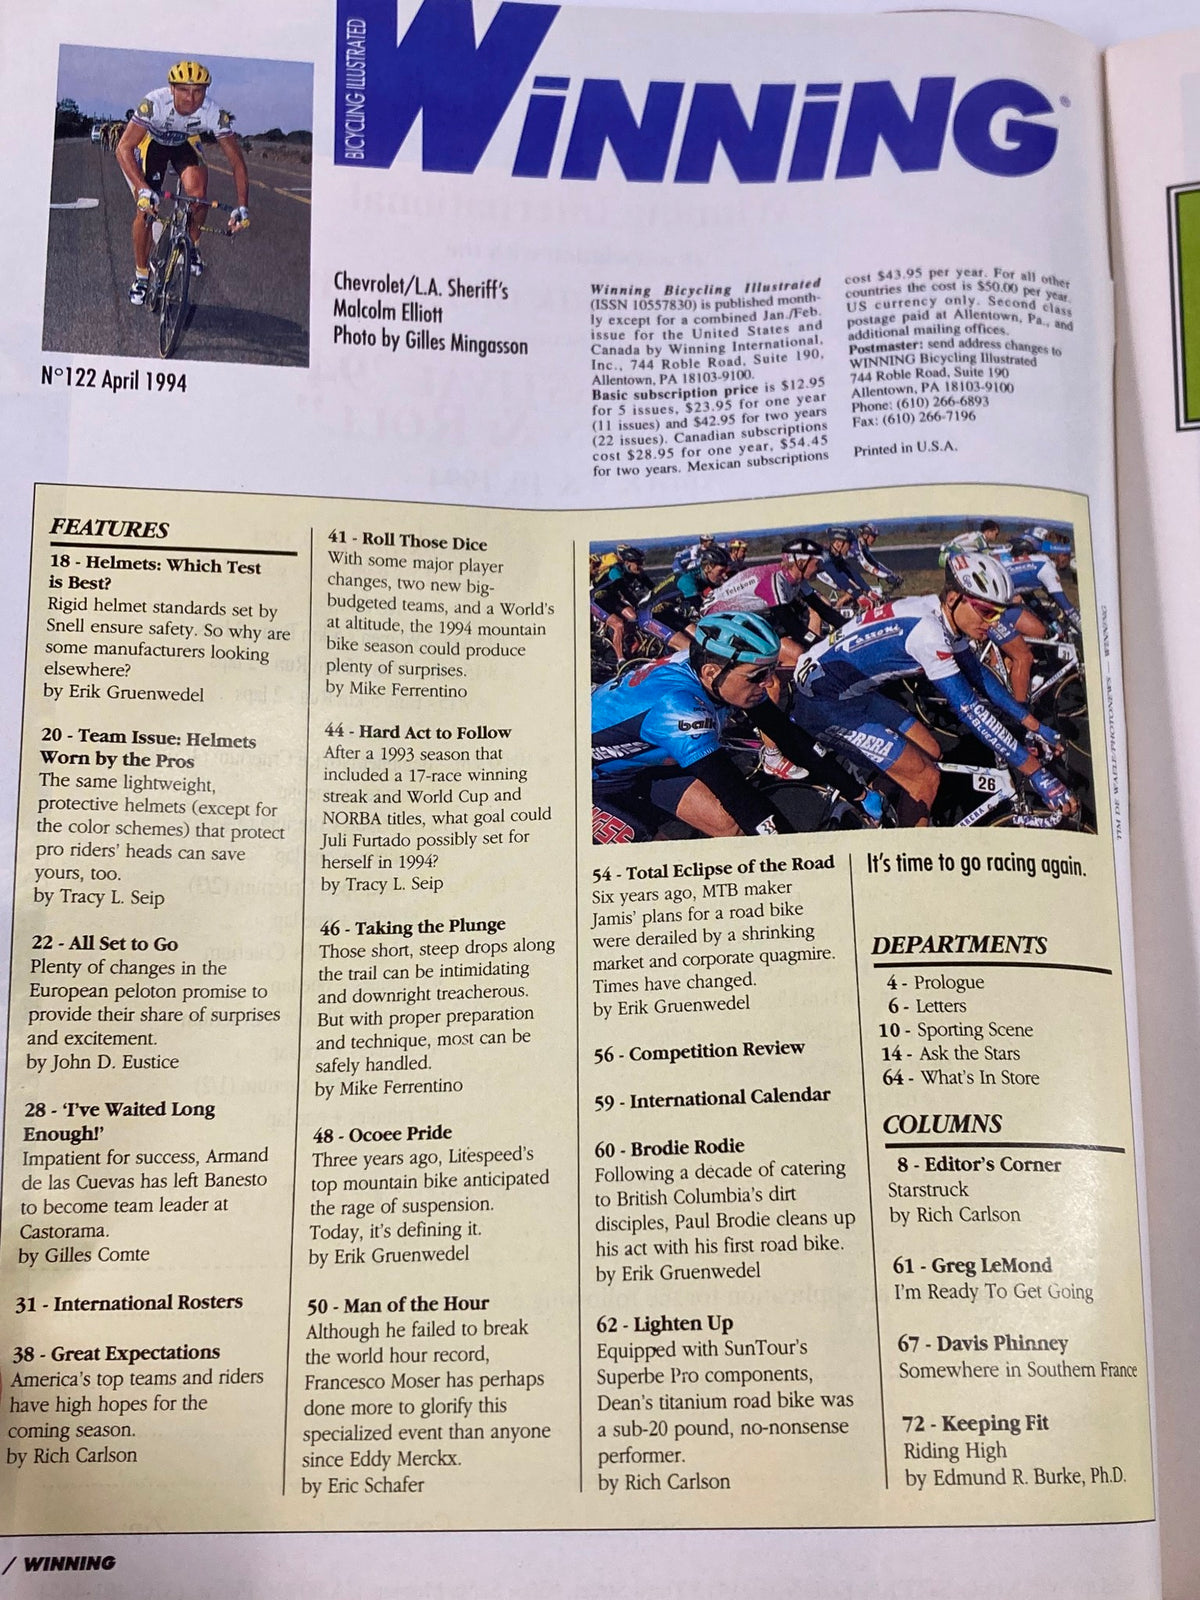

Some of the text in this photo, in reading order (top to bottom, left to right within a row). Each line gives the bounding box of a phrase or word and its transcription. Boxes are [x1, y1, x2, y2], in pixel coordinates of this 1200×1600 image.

[344, 18, 367, 160] BICYCLING ILLUSTRATED
[334, 270, 508, 300] Chevrolet/L.A. Sheriff's
[590, 277, 821, 300] Winning Bicycling Illustrated
[334, 297, 442, 324] Malcolm Elliott
[590, 297, 628, 312] (ISSN
[633, 298, 698, 313] 10557830)
[700, 298, 712, 311] is
[715, 295, 773, 312] published
[334, 323, 528, 358] Photo by Gilles Mingasson
[590, 342, 640, 357] Canada
[645, 343, 662, 359] by
[668, 341, 726, 357] Winning
[848, 336, 1063, 358] Postmaster: send address changes to
[630, 358, 654, 372] 744
[661, 356, 701, 371] Roble
[707, 354, 746, 370] Road,
[753, 352, 788, 366] Suite
[849, 350, 1038, 370] WINNING Bicycling Illustrated
[102, 369, 138, 393] April
[147, 371, 186, 392] 1994
[591, 368, 755, 387] Allentown, PA 18103-9100.
[850, 365, 1010, 385] 744 Roble Road, Suite 190
[591, 375, 825, 402] Basic subscription price is $12.95
[851, 379, 1015, 400] Allentown, PA 18103-9100
[851, 394, 990, 414] Phone: (610) 266-6893
[852, 409, 977, 429] Fax: (610) 266-7196
[853, 439, 960, 458] Printed in U.S.A.
[49, 517, 169, 539] FEATURES
[327, 528, 488, 552] 41 Roll Those Dice
[50, 553, 262, 576] 18 Helmets: Which Test
[48, 573, 112, 591] is Best?
[48, 596, 277, 622] Rigid helmet standards set by
[973, 704, 1018, 753] CARRERA
[978, 776, 996, 792] 26
[323, 805, 552, 828] NORBA titles, what goal could
[868, 852, 1086, 879] It's time to go racing again.
[643, 909, 682, 928] plans
[688, 905, 710, 922] for
[715, 909, 724, 921] a
[729, 902, 765, 920] road
[770, 900, 803, 917] bike
[31, 934, 179, 953] 22 All Set to Go
[871, 935, 1047, 955] DEPARTMENTS
[878, 1021, 1034, 1042] 10 Sporting Scene
[595, 1040, 805, 1065] 56 Competition Review
[313, 1124, 452, 1144] 48 Ocoee Pride
[883, 1114, 1002, 1135] COLUMNS
[893, 1255, 1052, 1278] 61 Greg LeMond
[16, 1293, 244, 1314] 31 International Rosters
[598, 1339, 807, 1364] Equipped with SunTour's
[899, 1359, 1137, 1379] Somewhere in Southern France
[10, 1393, 207, 1417] have high hopes for the
[24, 1555, 116, 1572] WINNING
